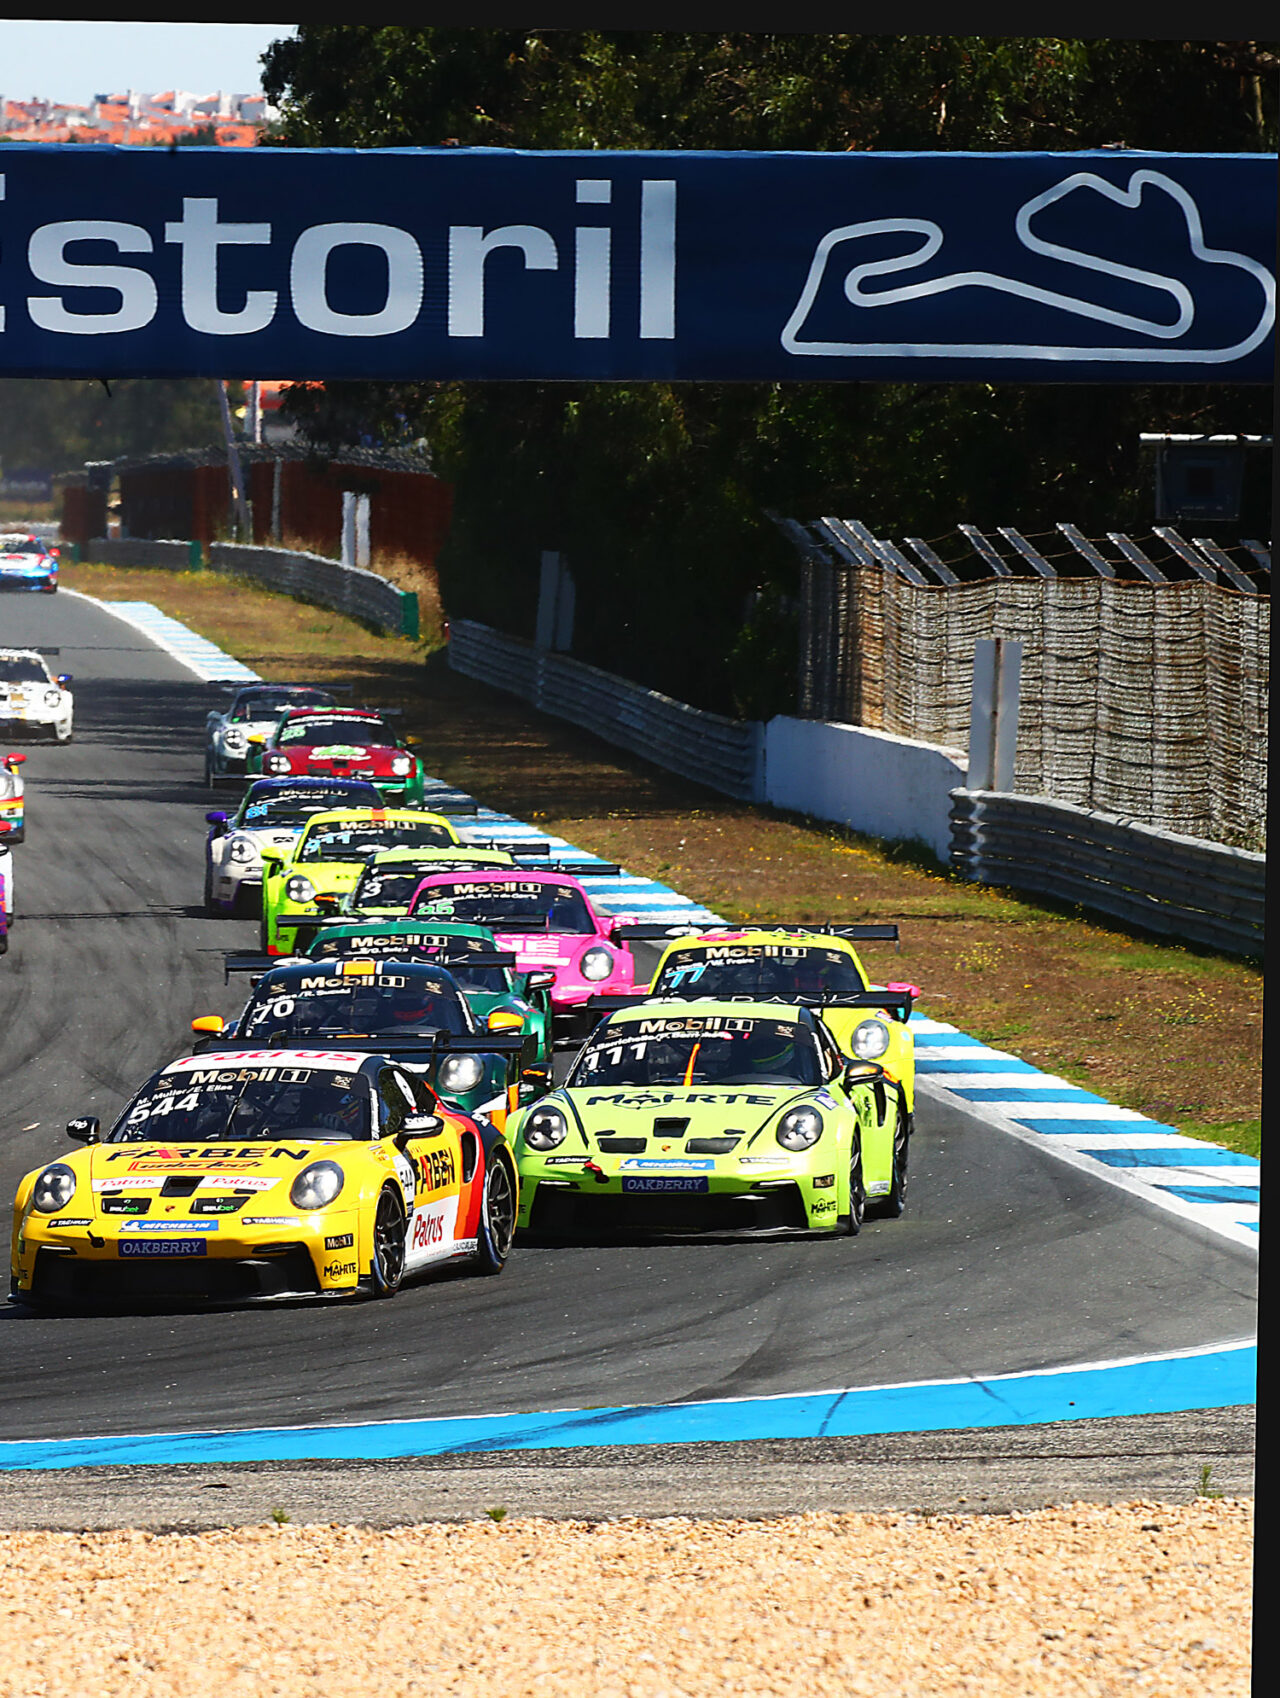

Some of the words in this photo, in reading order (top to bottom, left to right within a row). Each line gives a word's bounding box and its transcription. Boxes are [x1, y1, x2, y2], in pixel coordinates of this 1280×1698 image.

[339, 821, 395, 830] Mobil
[454, 882, 517, 894] Mobil
[352, 935, 421, 948] Mobil
[706, 947, 778, 959] Mobil
[301, 976, 374, 989] Mobil
[665, 966, 707, 988] 77
[253, 1001, 295, 1024] 70
[639, 1018, 722, 1034] Mobil
[584, 1042, 647, 1070] 111
[190, 1068, 275, 1085] Mobil
[128, 1094, 199, 1124] 544
[106, 1147, 310, 1162] FARBEN
[414, 1149, 456, 1196] FARBEN
[627, 1179, 703, 1191] OAKBERRY
[139, 1221, 210, 1230] MICHELIN
[413, 1214, 445, 1250] Patrus
[122, 1242, 201, 1254] OAKBERRY
